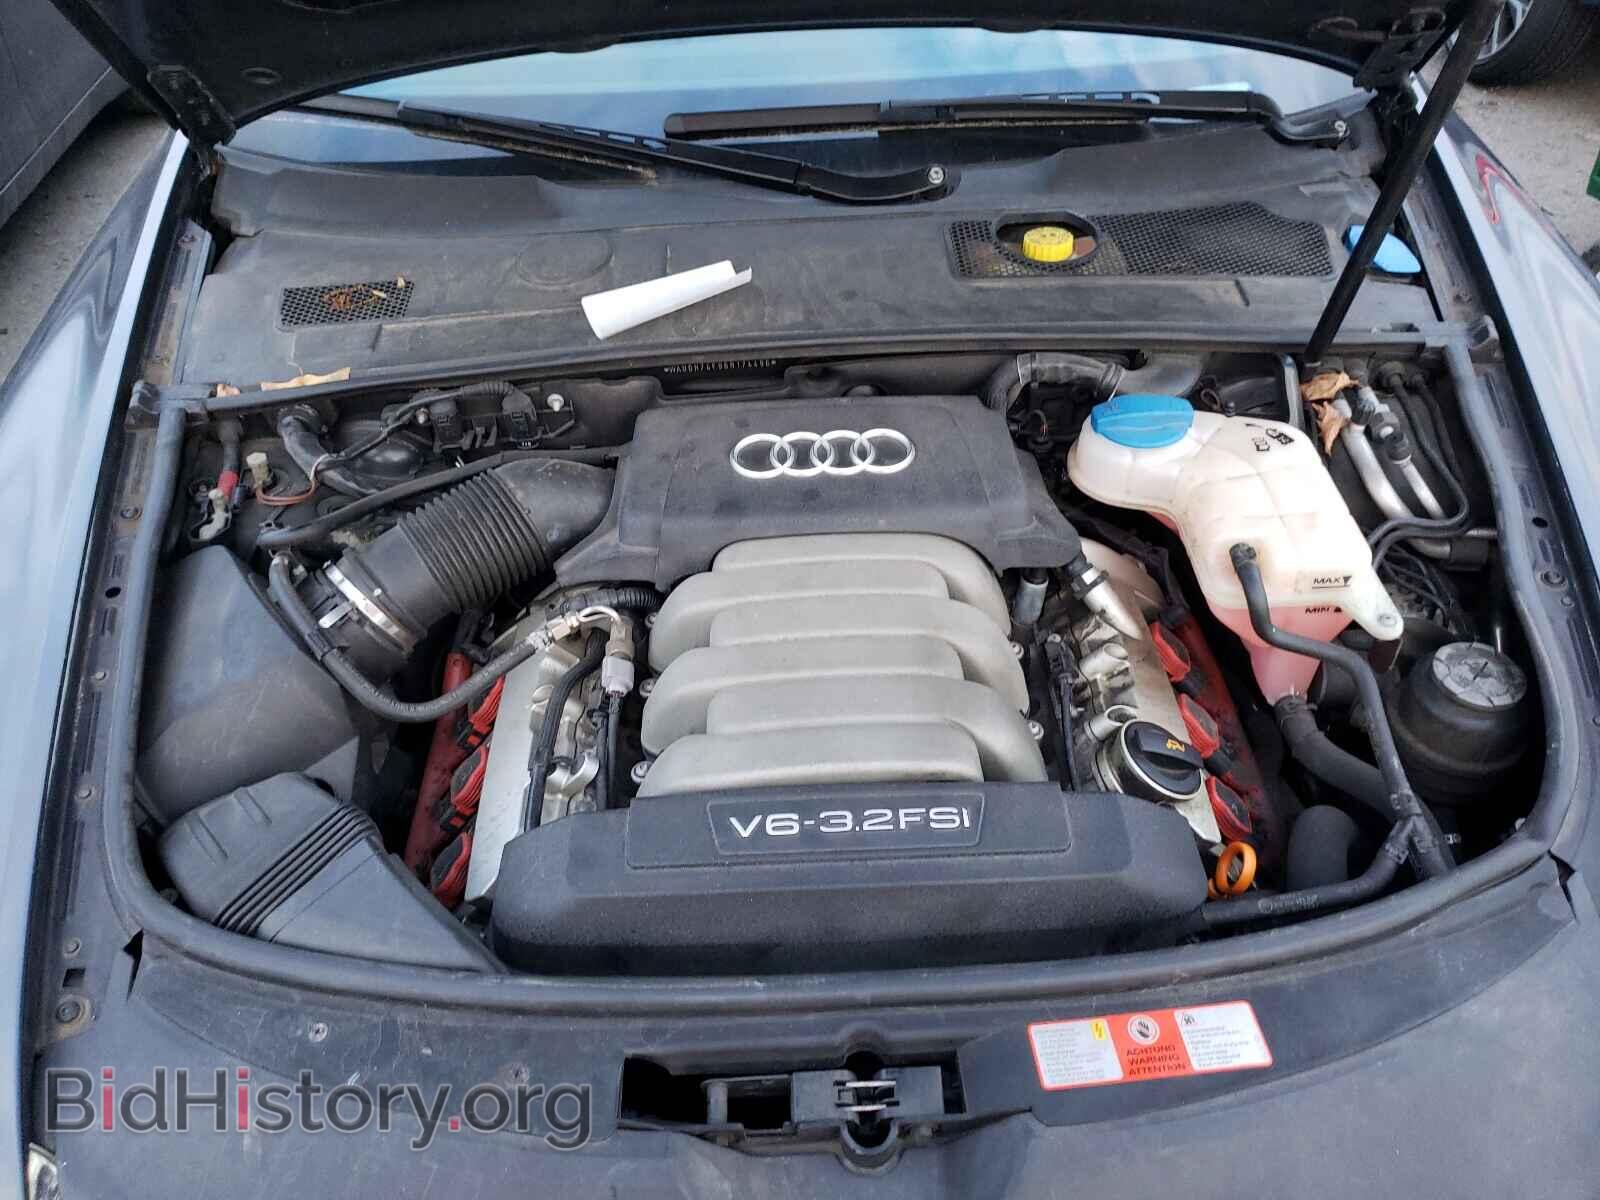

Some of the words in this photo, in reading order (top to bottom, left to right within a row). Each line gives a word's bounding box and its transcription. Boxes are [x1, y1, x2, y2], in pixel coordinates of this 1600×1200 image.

[1313, 577, 1340, 585] MAX
[1304, 606, 1330, 614] MIN
[1128, 1054, 1180, 1066] WARNING
[1128, 1063, 1187, 1076] ATTENTION
